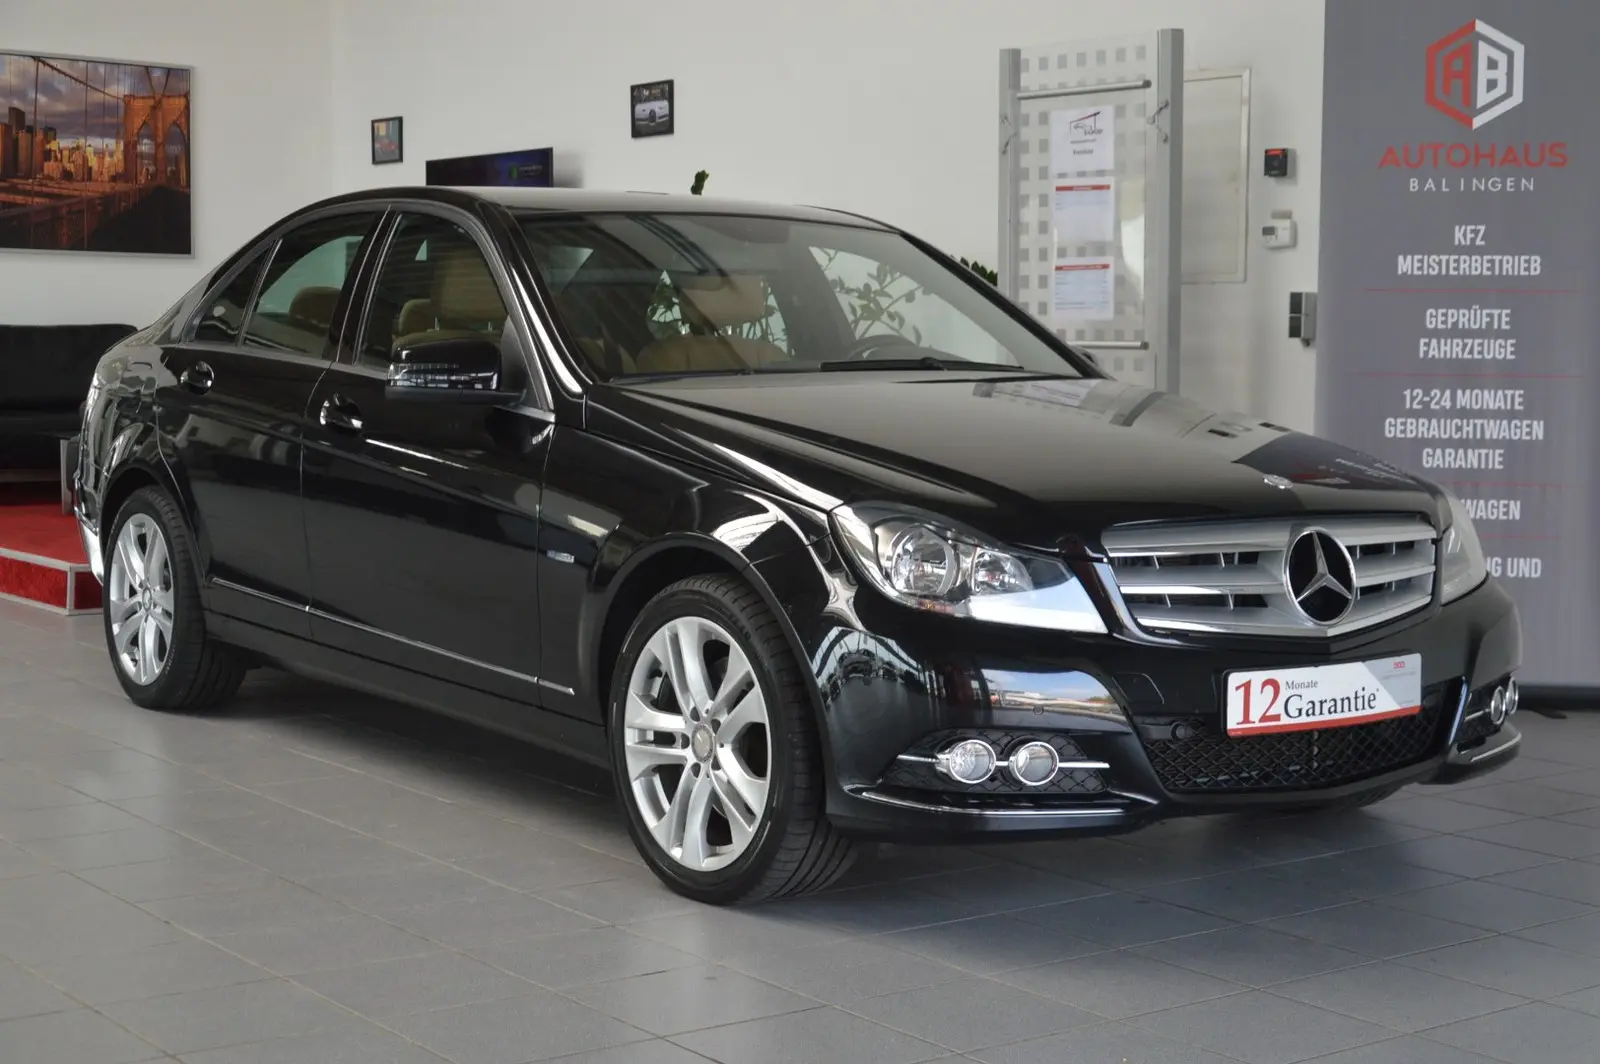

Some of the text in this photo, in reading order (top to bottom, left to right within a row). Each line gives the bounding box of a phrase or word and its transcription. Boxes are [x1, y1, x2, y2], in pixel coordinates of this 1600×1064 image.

[1379, 142, 1568, 169] AUTOHAUS
[1409, 177, 1534, 192] BALINGEN
[1454, 225, 1486, 246] KFZ
[1397, 255, 1541, 276] MEISTERBETRIEB
[1426, 305, 1511, 329] GEPRÜFTE
[1419, 338, 1516, 359] FAHRZEUGE
[1403, 388, 1524, 410] 12-24 MONATE
[1384, 418, 1544, 440] GEBRAUCHTWAGEN
[1422, 448, 1504, 469] GARANTIE
[1507, 557, 1541, 578] UND
[1235, 678, 1318, 725] 12 Monate
